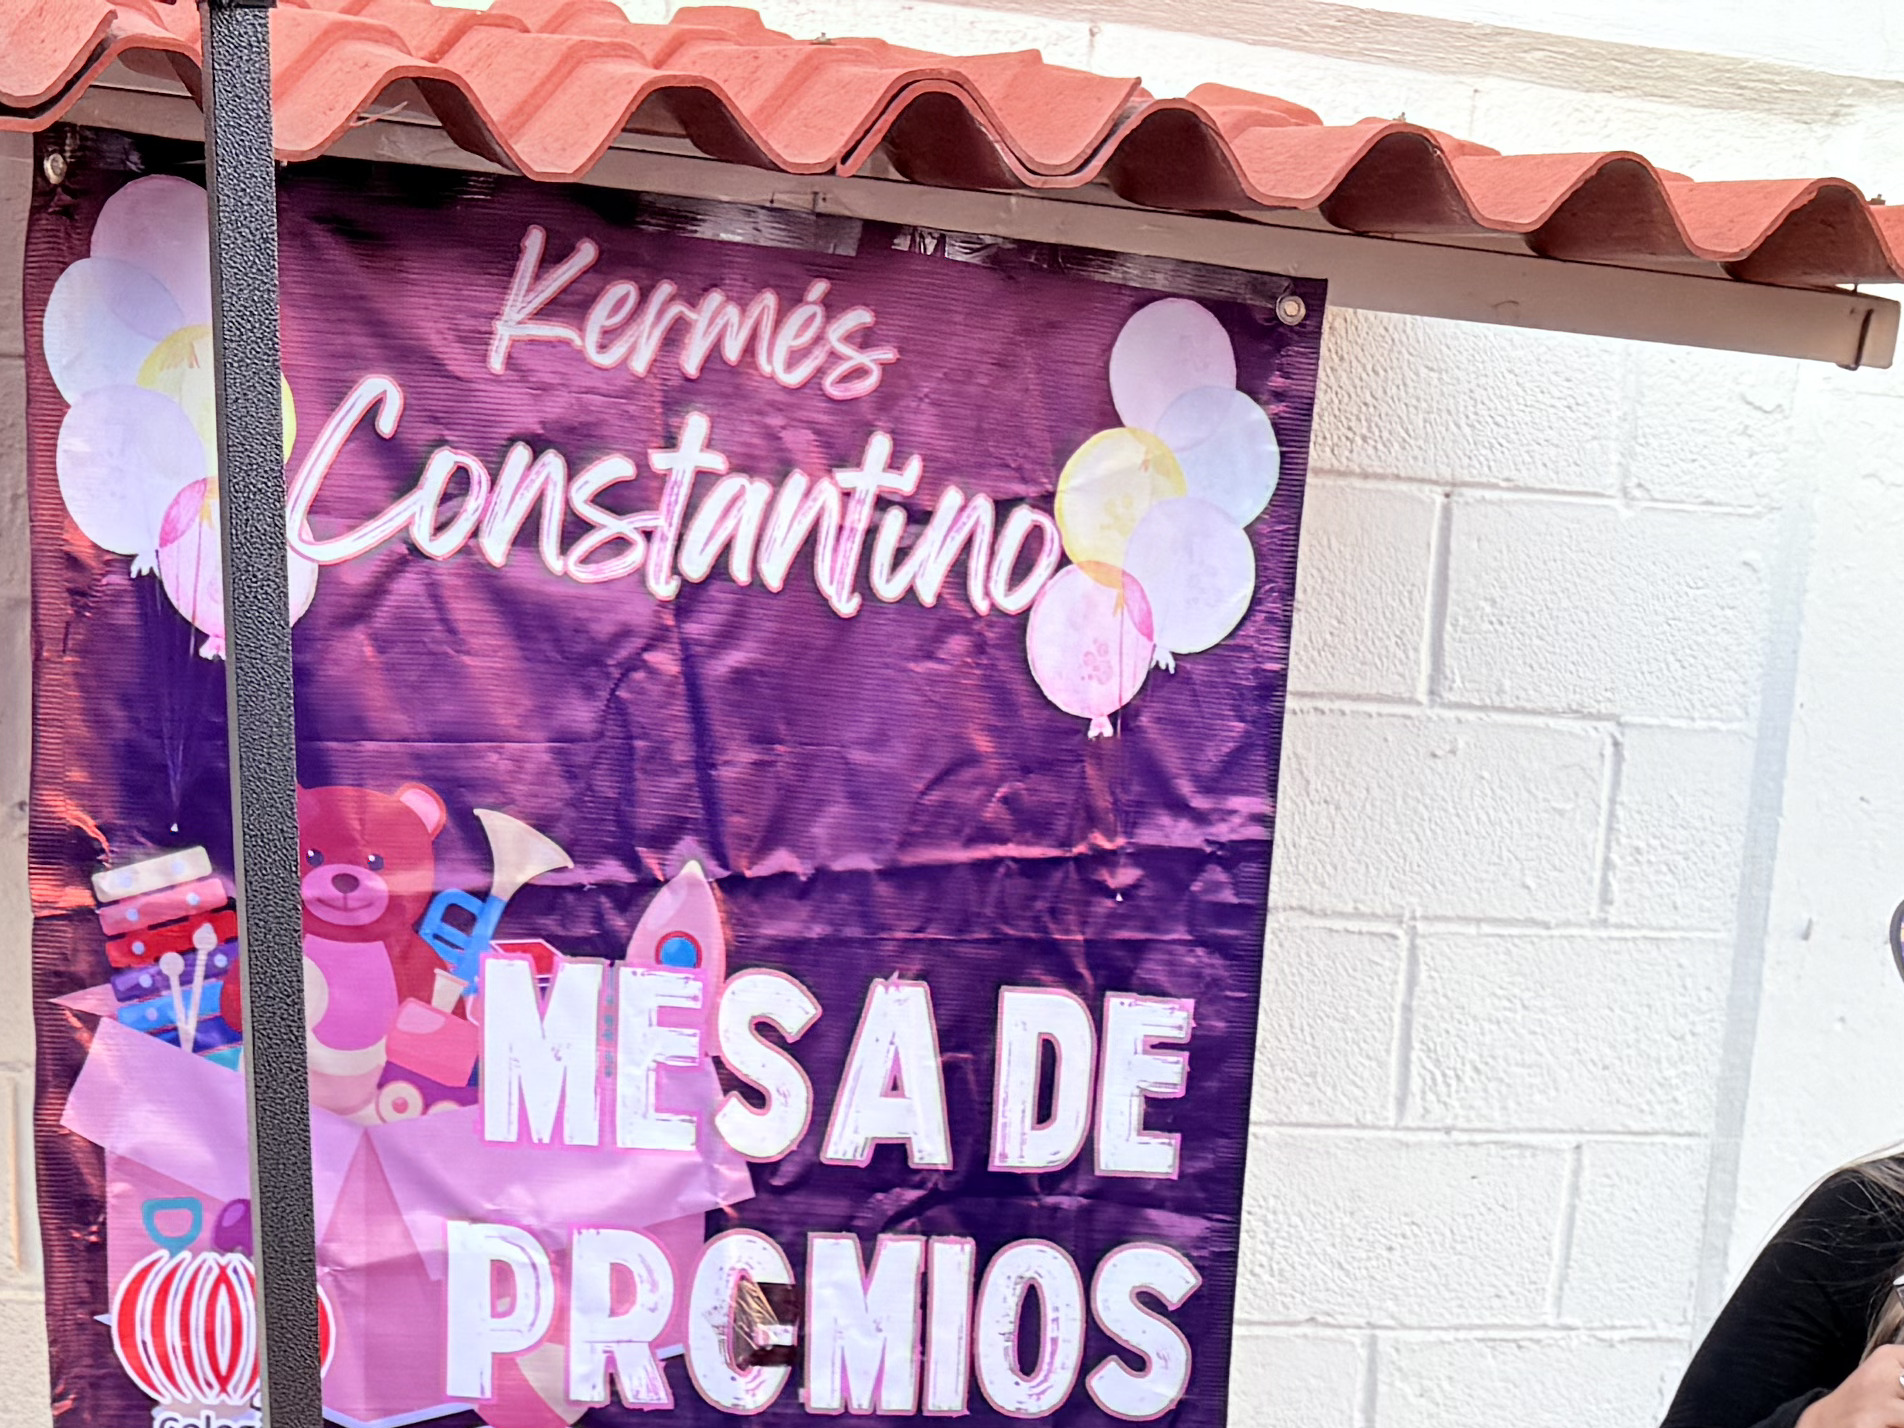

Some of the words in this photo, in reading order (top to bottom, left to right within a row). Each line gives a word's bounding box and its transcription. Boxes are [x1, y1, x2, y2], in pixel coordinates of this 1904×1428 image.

[486, 226, 897, 399] Kermés
[284, 373, 1066, 620] Constantino
[479, 953, 954, 1172] MESA
[990, 988, 1195, 1178] DE
